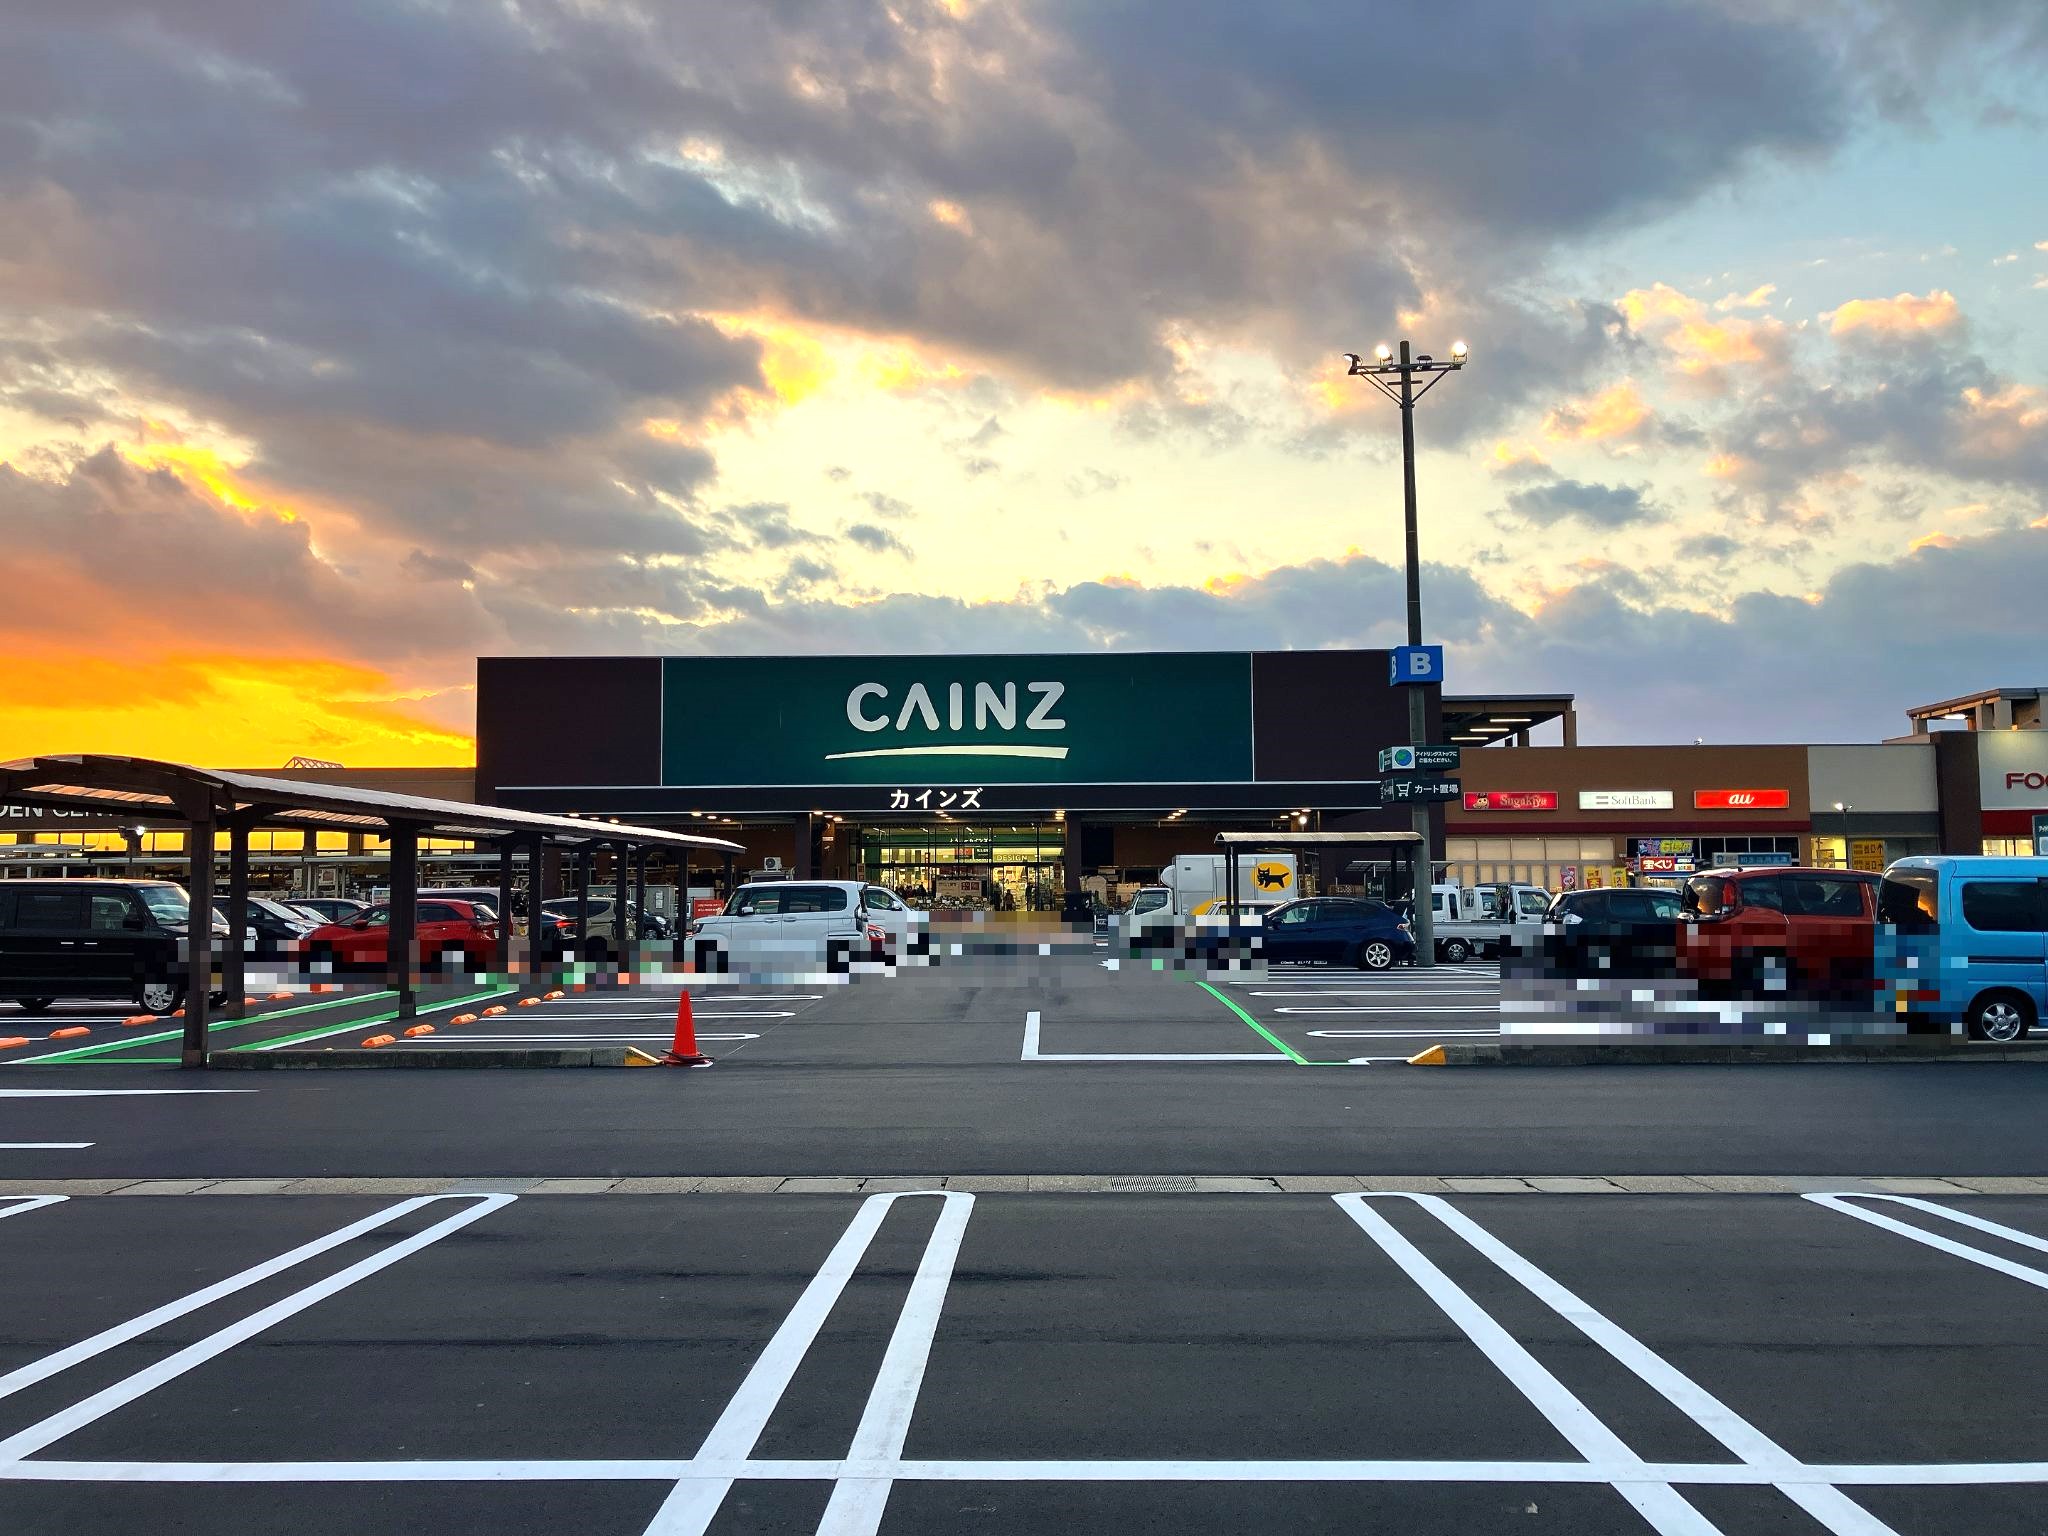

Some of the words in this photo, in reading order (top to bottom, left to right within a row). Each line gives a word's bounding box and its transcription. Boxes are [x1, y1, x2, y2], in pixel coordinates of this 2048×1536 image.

[1410, 653, 1431, 674] B
[847, 682, 1066, 731] CAINZ
[2006, 773, 2048, 789] FO
[1414, 784, 1459, 794] カート置場
[890, 787, 983, 809] カインズ
[1611, 796, 1656, 805] SoftBank
[1729, 794, 1754, 805] au
[1643, 859, 1673, 870] 宝くじ
